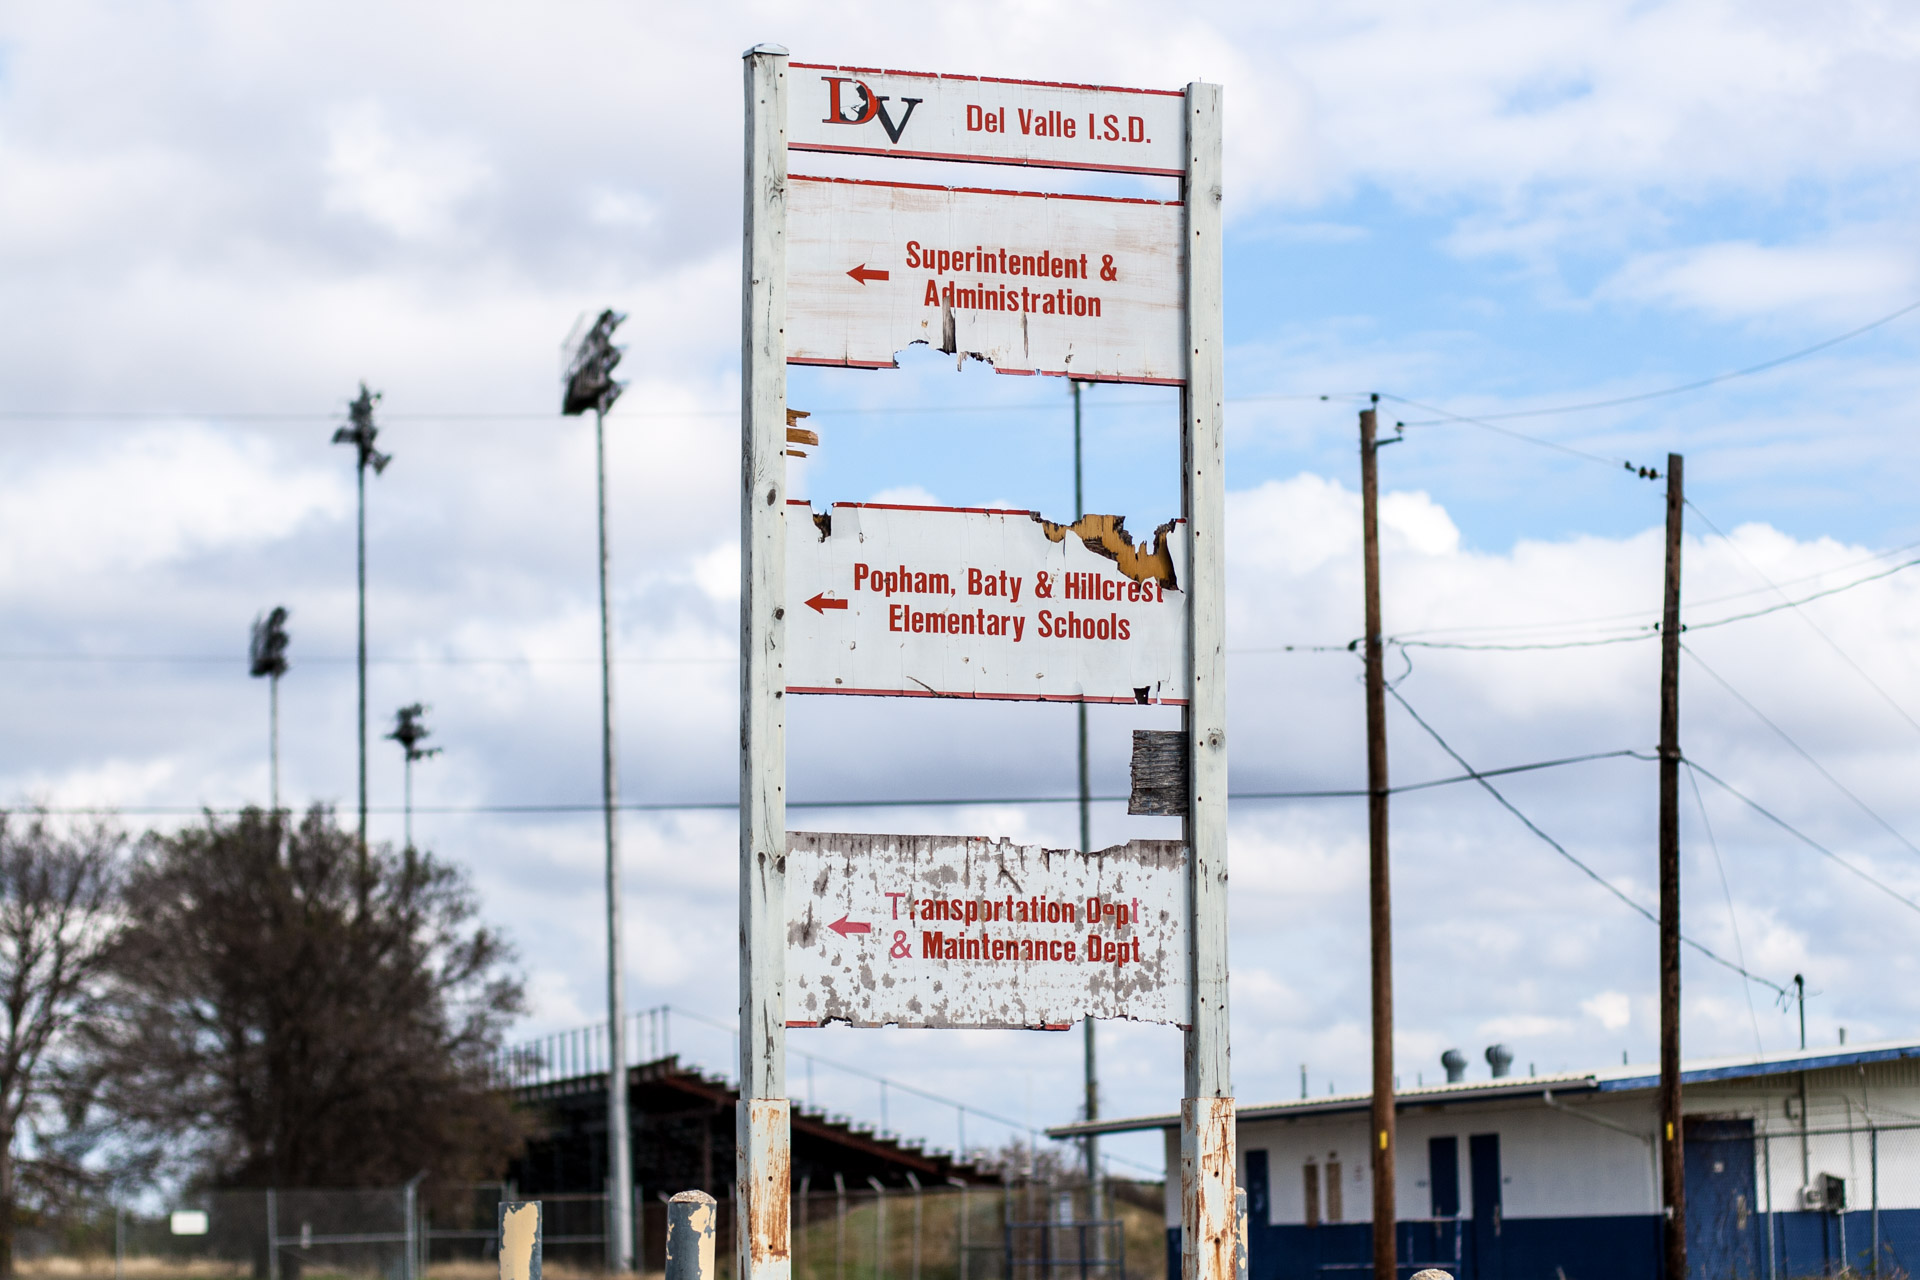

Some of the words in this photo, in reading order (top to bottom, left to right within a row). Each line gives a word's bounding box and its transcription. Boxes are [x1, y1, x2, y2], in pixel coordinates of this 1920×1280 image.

[966, 104, 1005, 133] Del
[1018, 108, 1076, 138] Valle
[1089, 114, 1151, 144] I.S.D.
[906, 240, 1088, 279] Superintendent
[1100, 254, 1118, 282] &
[924, 279, 1101, 317] Administration
[854, 563, 956, 598] Popham,
[968, 568, 1022, 603] Baty
[1035, 571, 1053, 599] &
[1065, 572, 1164, 603] Hillcrest
[889, 604, 1025, 642] Elementary
[1038, 610, 1131, 640] Schools
[885, 892, 1076, 927] Transportation
[890, 930, 912, 959] &
[922, 931, 1077, 961] Maintenance
[1087, 934, 1141, 968] Dept
